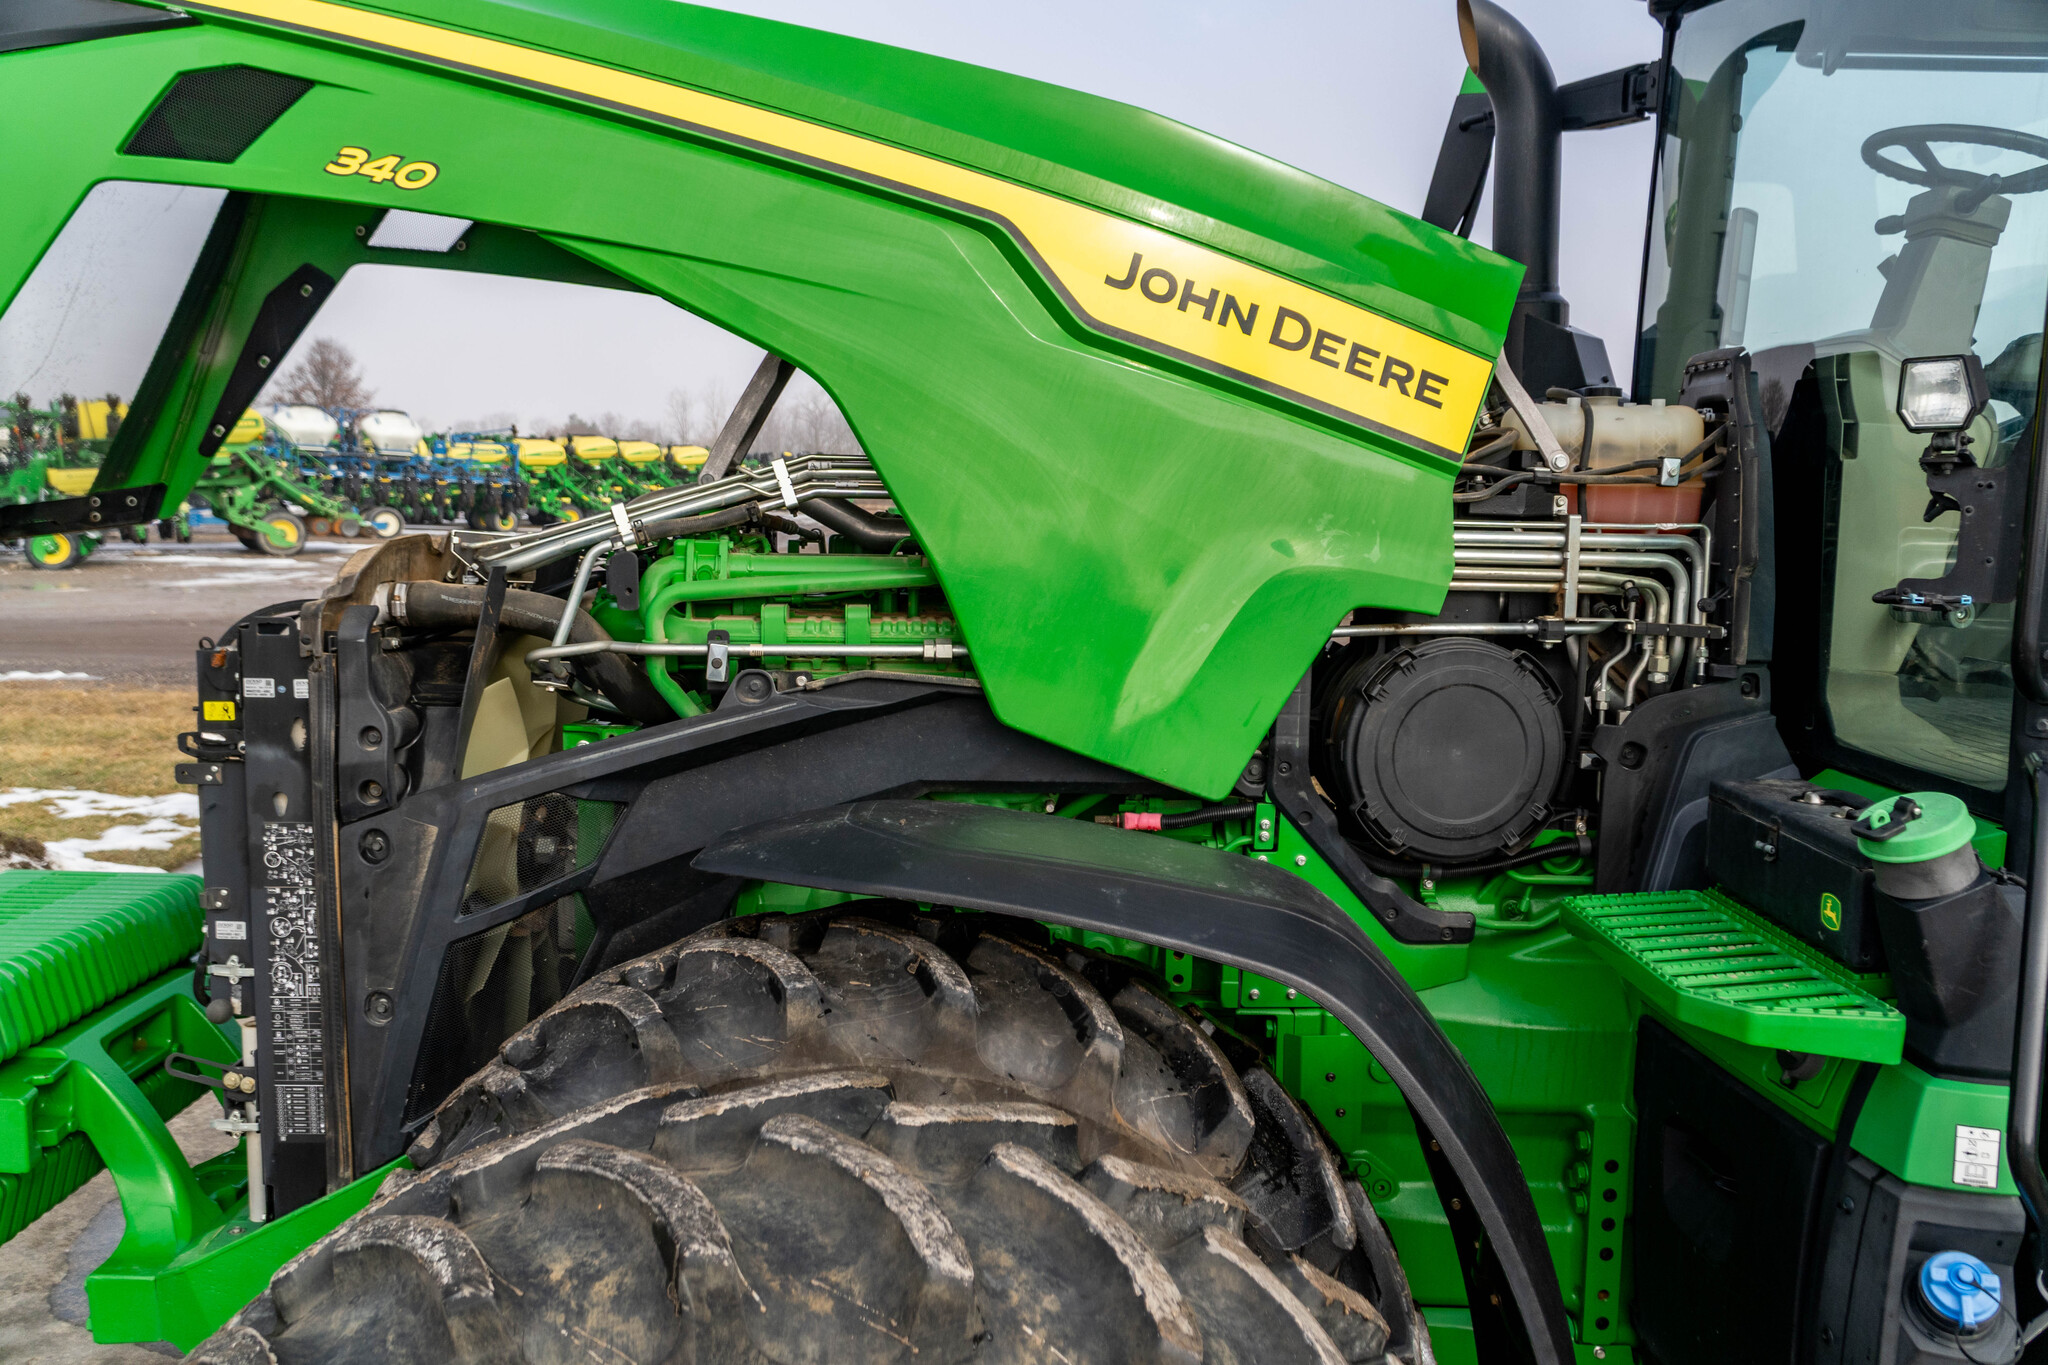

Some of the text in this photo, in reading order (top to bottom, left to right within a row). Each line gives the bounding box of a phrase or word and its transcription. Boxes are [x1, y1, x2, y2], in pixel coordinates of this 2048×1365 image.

[323, 145, 440, 191] 340
[1103, 251, 1450, 410] JOHN DEERE
